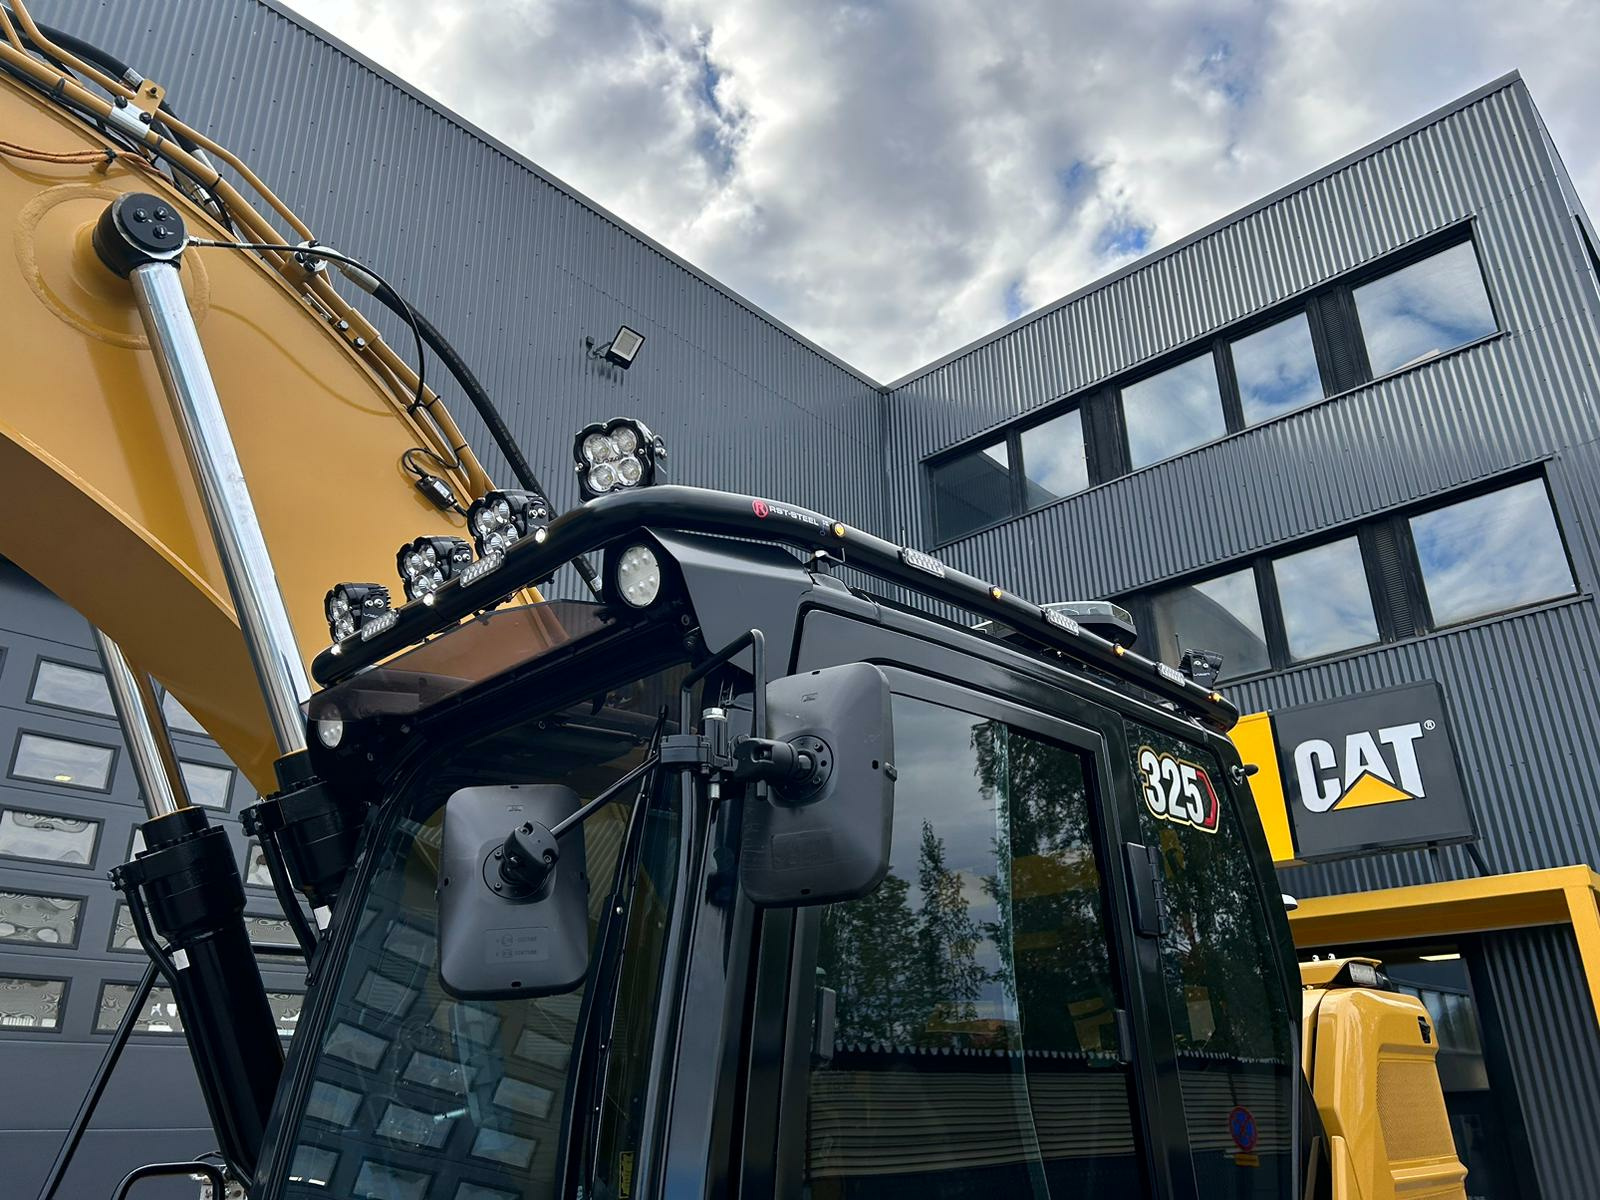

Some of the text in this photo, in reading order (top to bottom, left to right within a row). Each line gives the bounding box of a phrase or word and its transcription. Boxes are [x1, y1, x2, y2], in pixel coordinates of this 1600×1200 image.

[768, 505, 819, 526] RST-STEEL
[1141, 751, 1204, 824] 325
[1294, 722, 1426, 813] CAT
